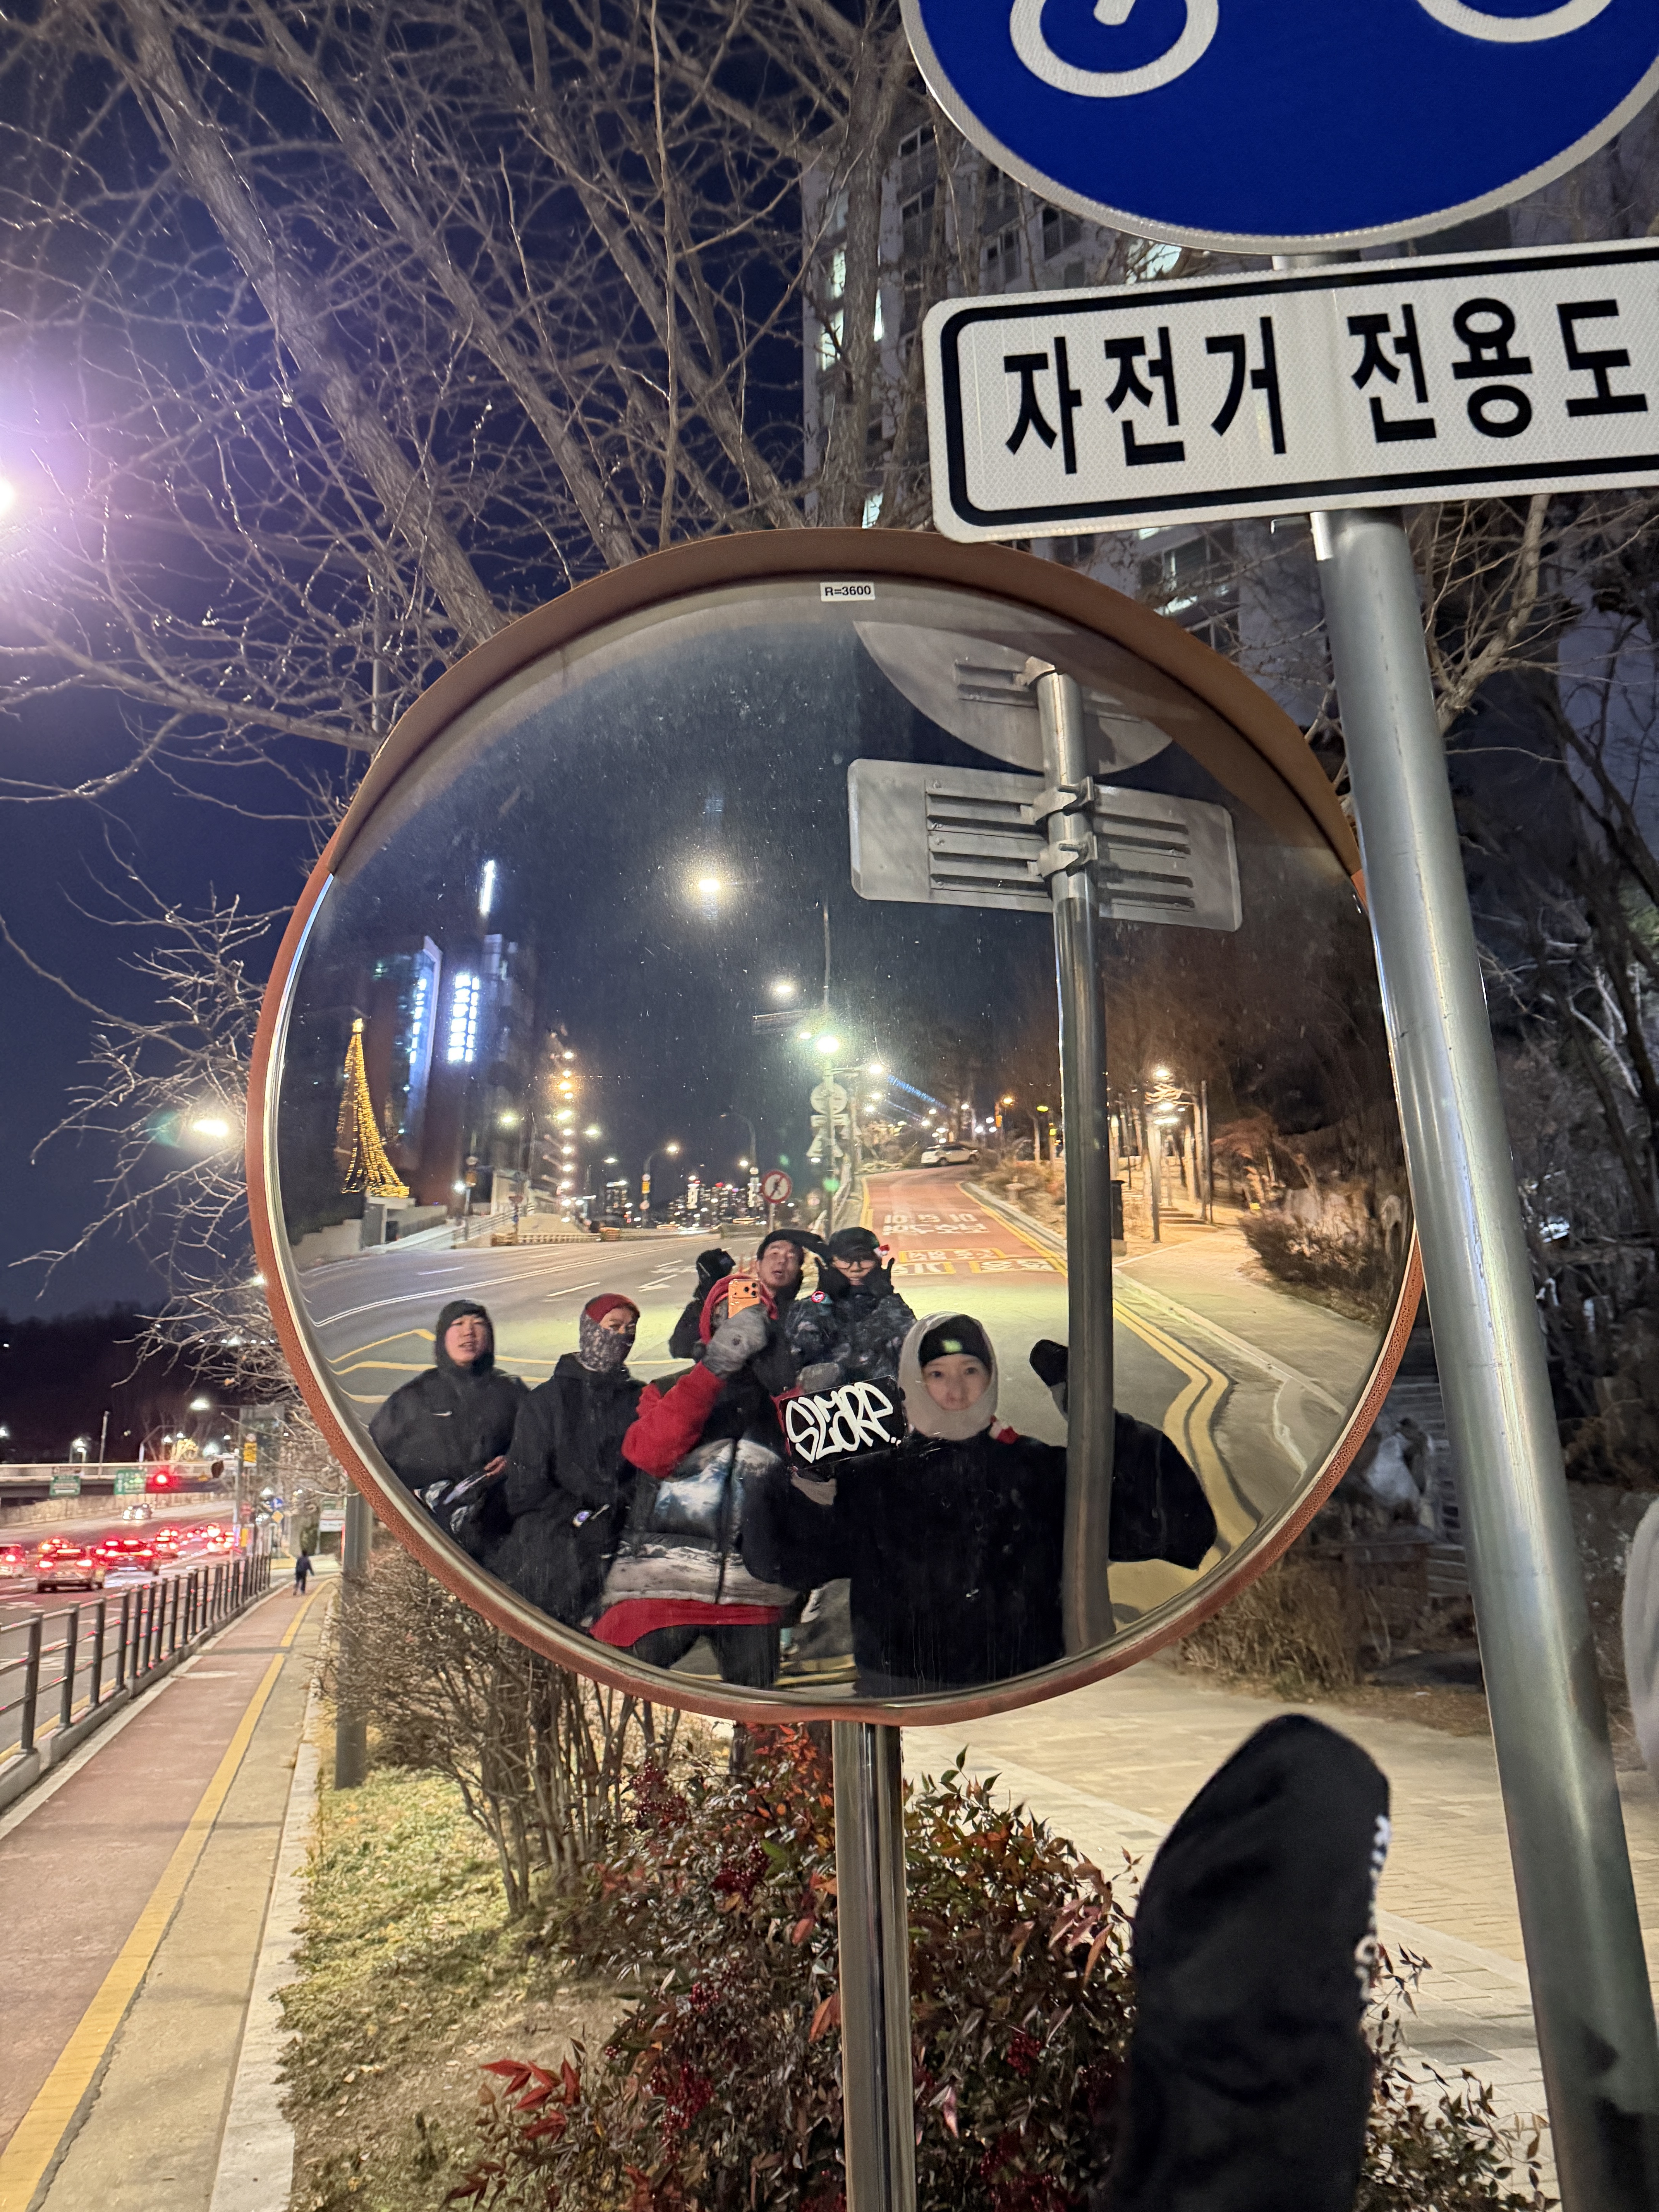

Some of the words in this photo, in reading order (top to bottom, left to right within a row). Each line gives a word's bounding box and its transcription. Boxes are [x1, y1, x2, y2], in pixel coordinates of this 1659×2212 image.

[1004, 317, 1286, 475] 자전거
[1348, 298, 1649, 443] 전용도
[824, 586, 871, 596] R=3600
